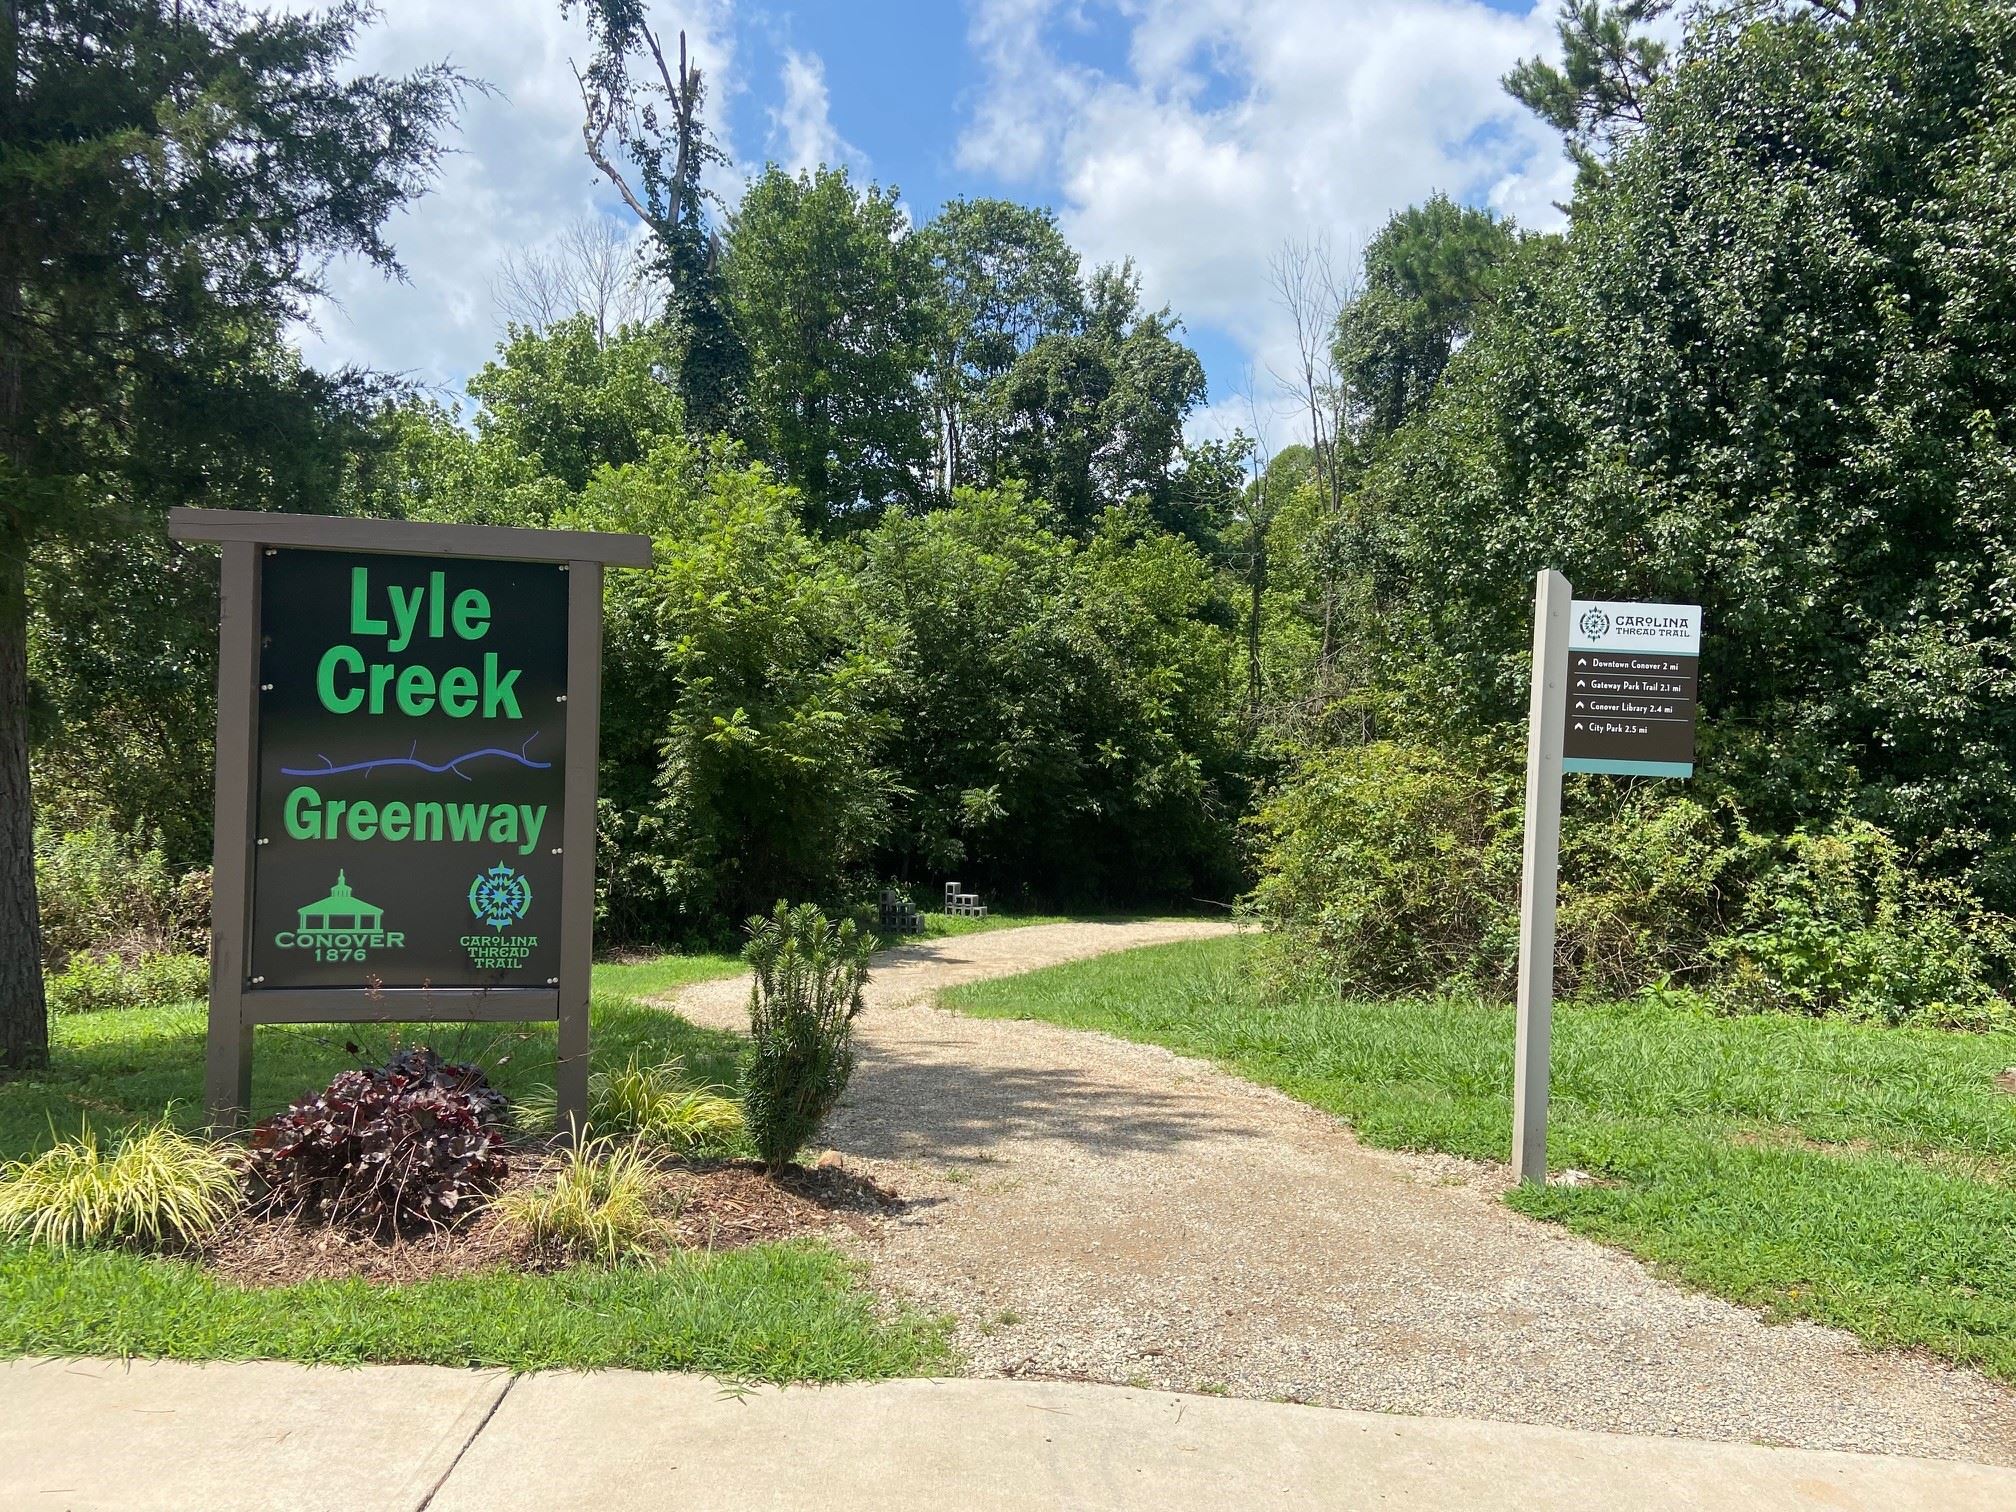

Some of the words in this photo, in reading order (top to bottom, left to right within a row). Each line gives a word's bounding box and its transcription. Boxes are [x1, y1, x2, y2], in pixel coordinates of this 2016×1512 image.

[351, 567, 491, 652] Lyle
[1616, 616, 1688, 628] CAROLINA
[1616, 628, 1655, 636] THREAD
[1593, 659, 1629, 668] Downtown
[1632, 660, 1660, 670] Conover
[1670, 663, 1678, 671] mi
[316, 645, 522, 718] Creek
[1591, 680, 1620, 691] Gateway
[1623, 681, 1639, 690] Park
[1642, 682, 1658, 691] Trail
[1660, 684, 1670, 692] 2.1
[1590, 701, 1619, 711] Conover
[1622, 703, 1647, 714] Library
[1589, 723, 1603, 733] City
[1606, 724, 1622, 732] Park
[1625, 725, 1636, 733] 2.5
[284, 786, 547, 855] Greenway
[275, 932, 405, 948] CONOVER
[460, 936, 537, 947] CAROLINA
[315, 949, 366, 962] 1876
[468, 947, 529, 958] THREAD
[474, 958, 522, 969] TRAIL
